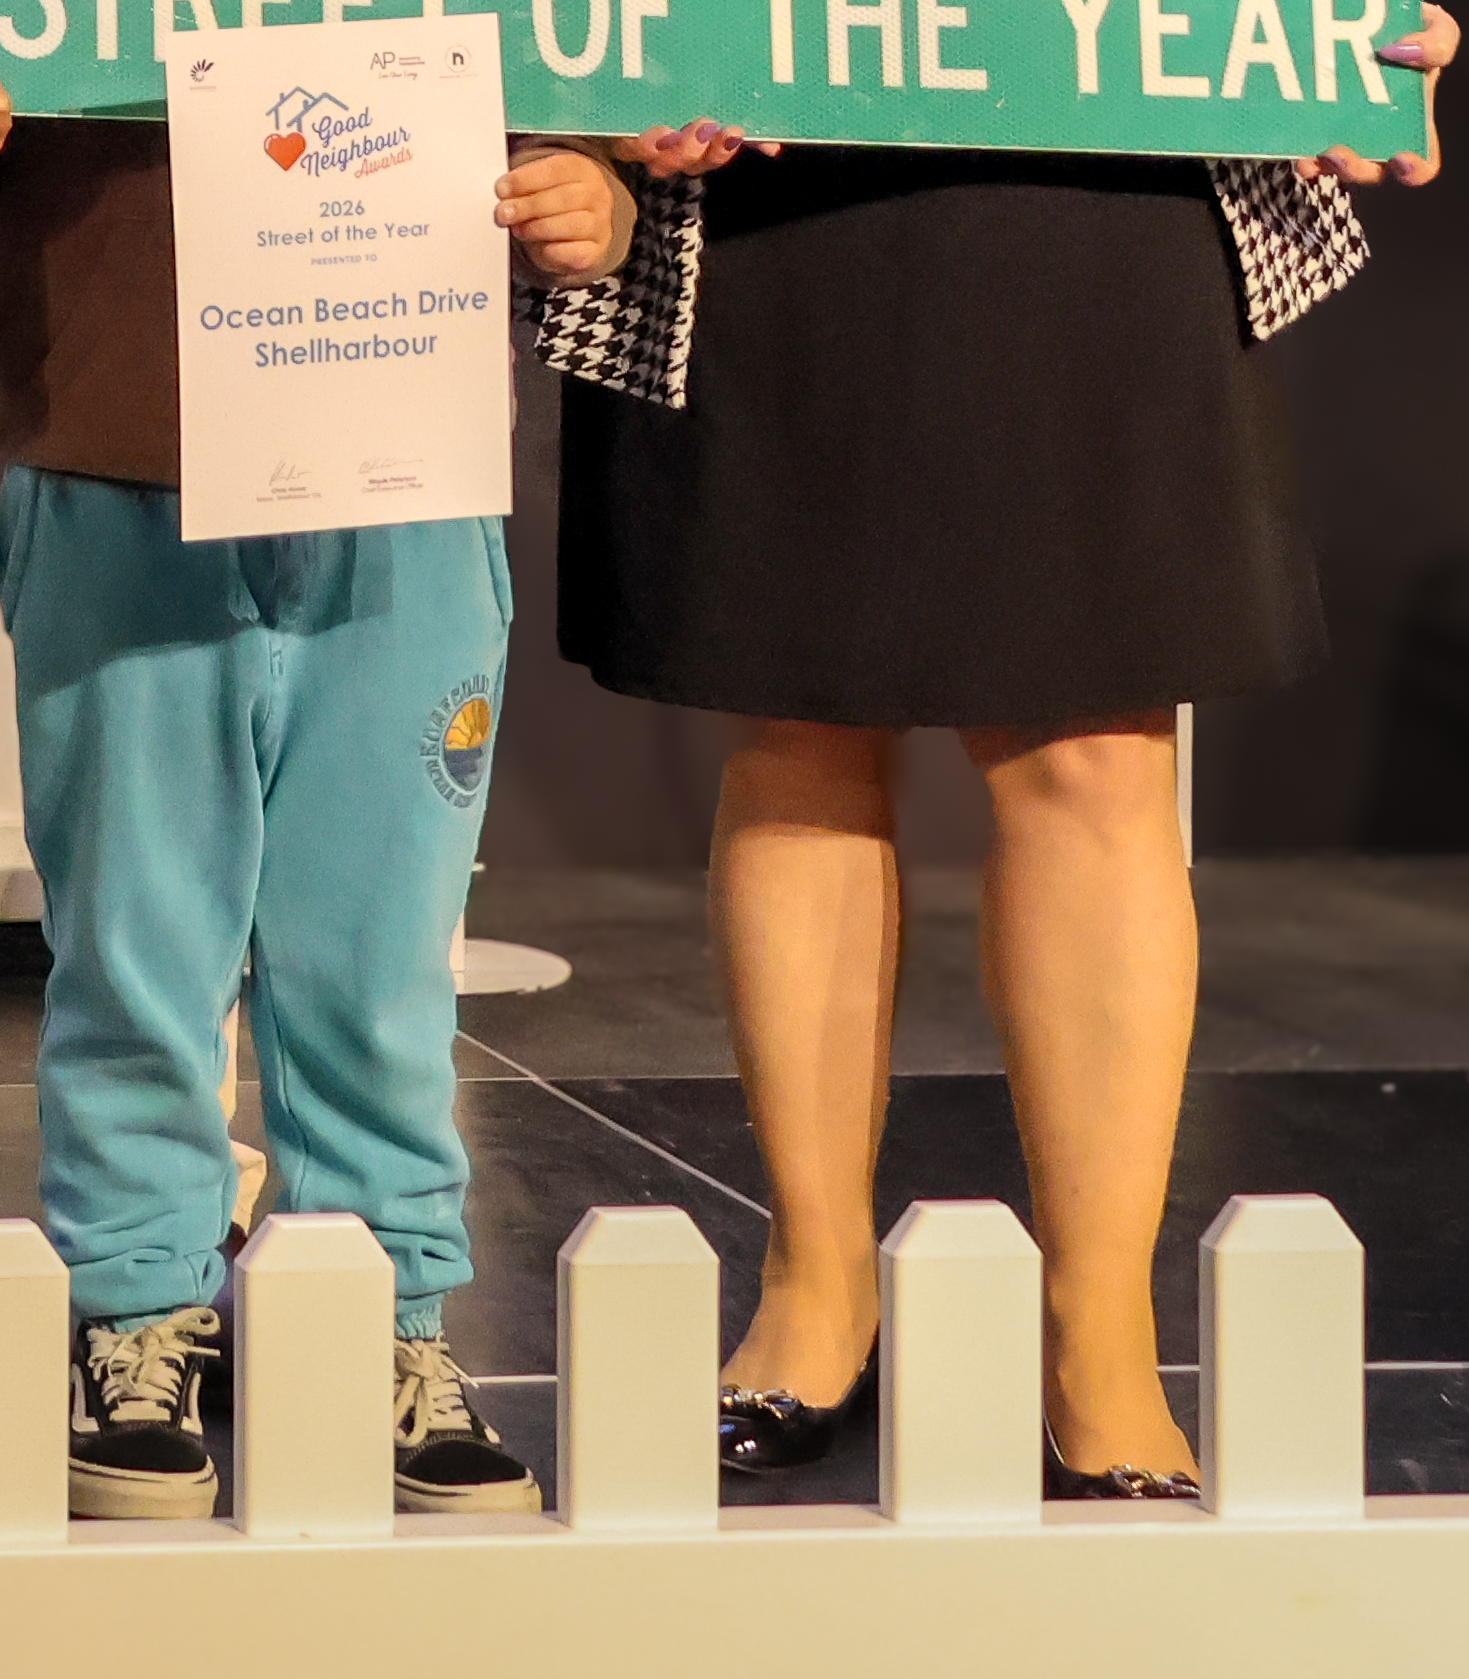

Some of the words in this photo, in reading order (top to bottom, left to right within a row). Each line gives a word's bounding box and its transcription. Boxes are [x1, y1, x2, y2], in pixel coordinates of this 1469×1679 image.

[312, 106, 373, 148] Good
[300, 126, 411, 177] Neighbour
[354, 147, 413, 178] Awards
[320, 200, 366, 217] 2026
[257, 230, 313, 248] Street
[321, 227, 342, 244] of
[346, 225, 378, 241] the
[385, 222, 430, 238] Year
[199, 303, 304, 331] Ocean
[315, 293, 407, 325] Beach
[419, 289, 489, 314] Drive
[255, 332, 438, 368] Shellharbour
